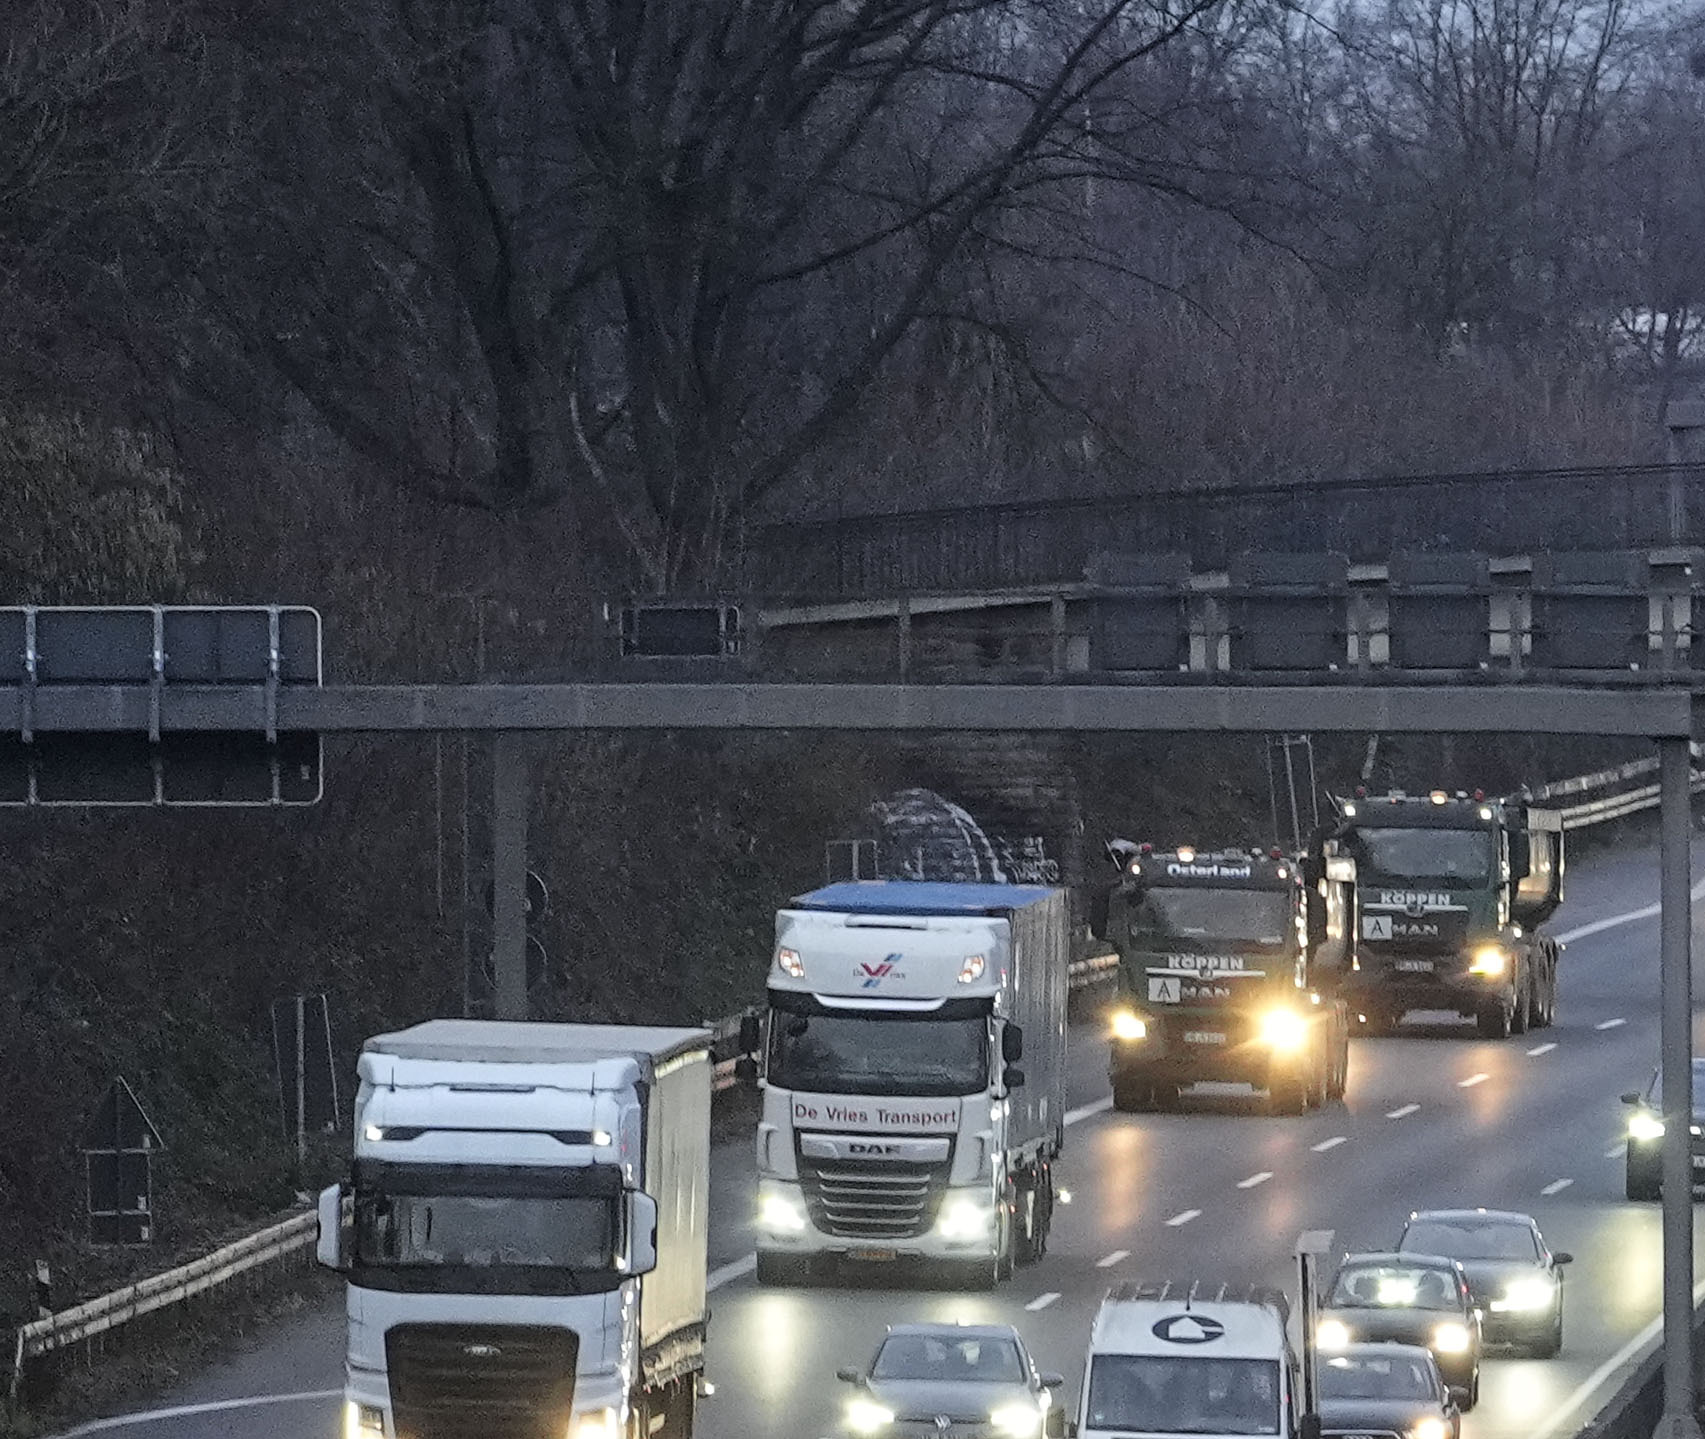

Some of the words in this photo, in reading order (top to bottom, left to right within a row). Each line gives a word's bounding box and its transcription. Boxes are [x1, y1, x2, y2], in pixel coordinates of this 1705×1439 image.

[1380, 889, 1450, 905] KÖPPEN
[1371, 917, 1384, 936] A
[1391, 924, 1439, 936] MAN
[1157, 980, 1171, 1000] A
[795, 1104, 818, 1119] De
[826, 1107, 868, 1122] Vries
[876, 1109, 956, 1127] Transport
